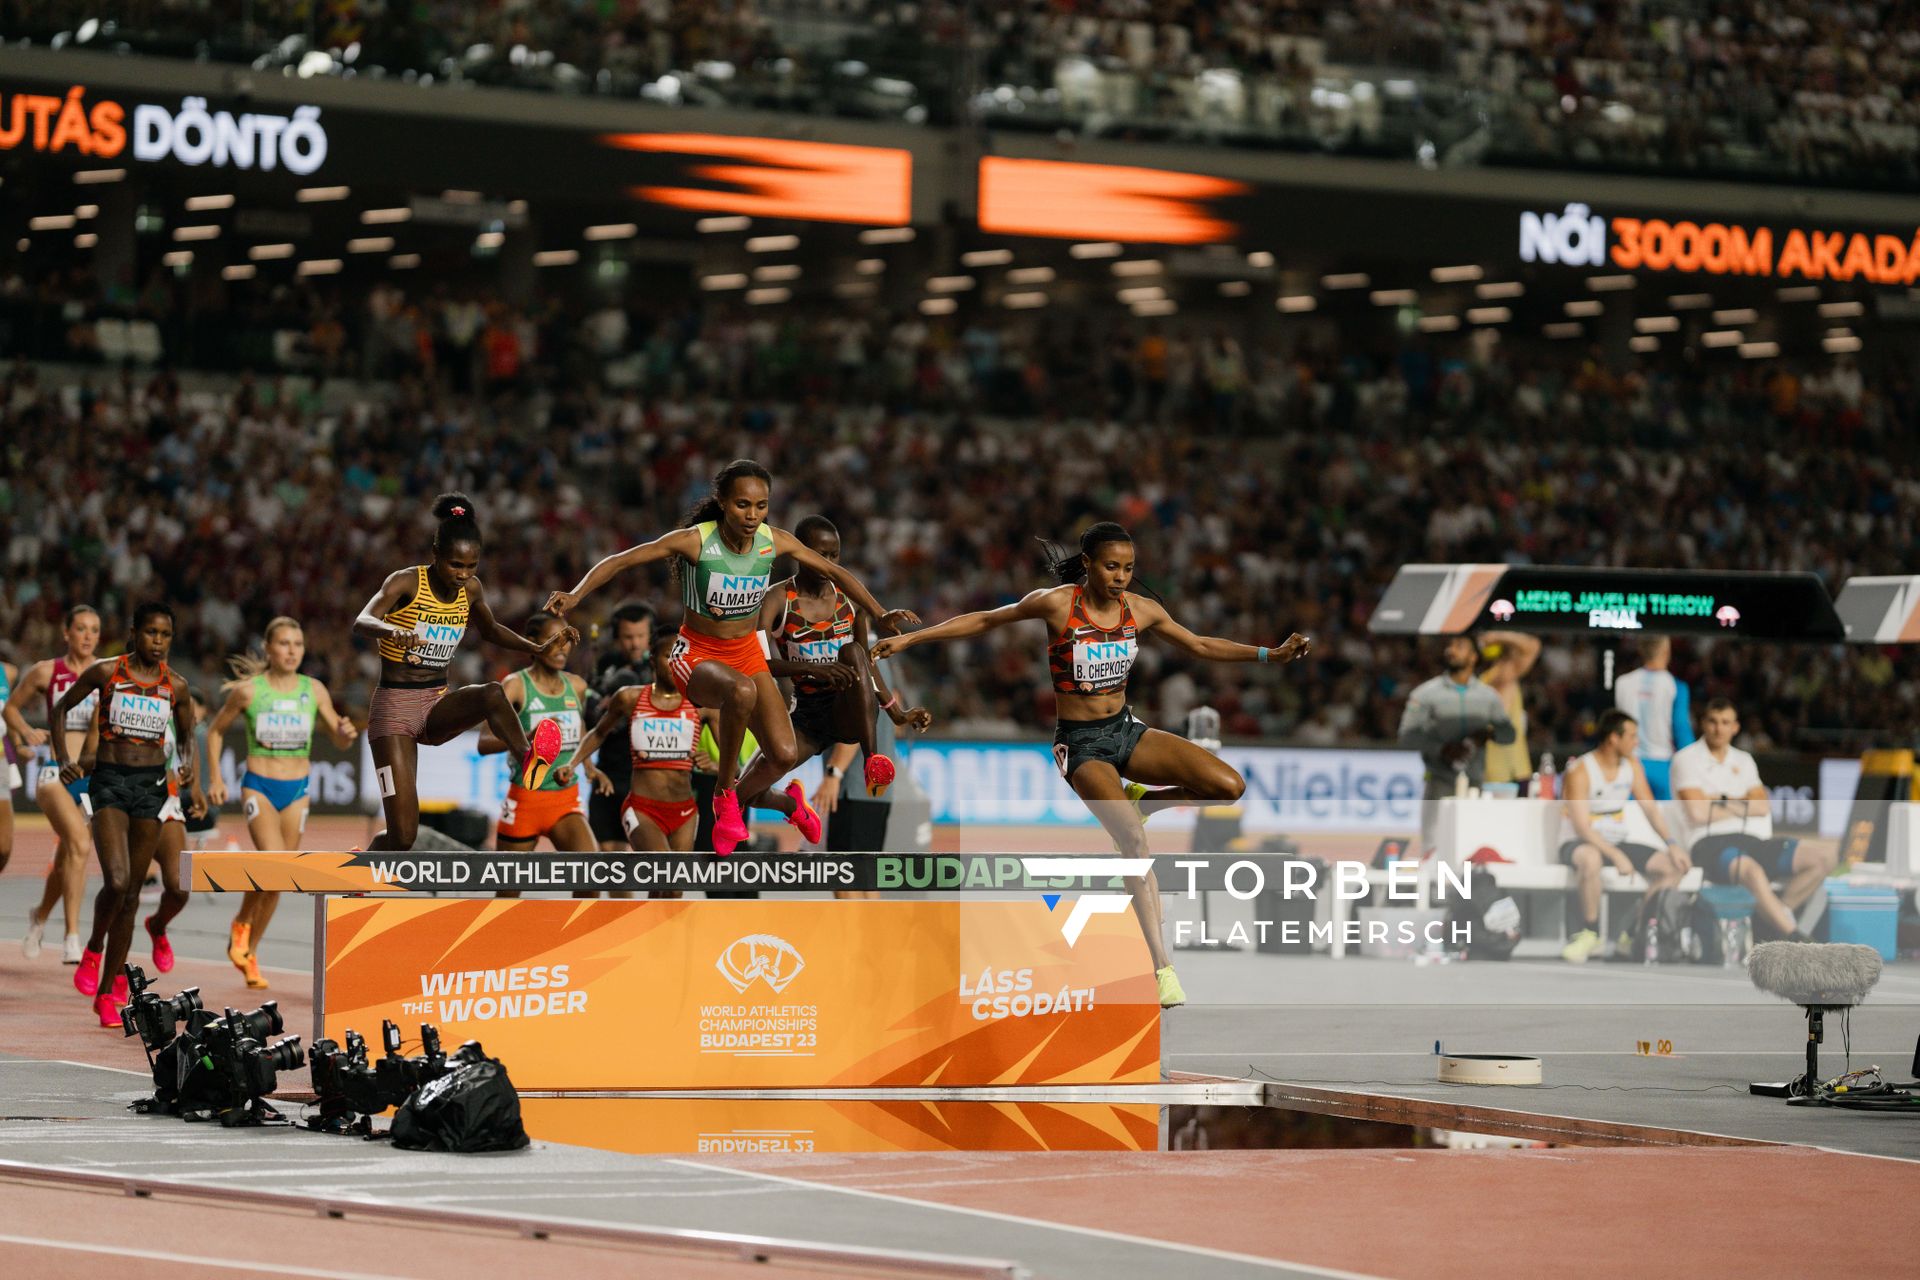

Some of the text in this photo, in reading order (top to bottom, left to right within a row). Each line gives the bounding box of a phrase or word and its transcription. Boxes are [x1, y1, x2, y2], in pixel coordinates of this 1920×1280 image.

[1611, 217, 1773, 277] 3000M
[723, 576, 767, 591] NTN
[1574, 591, 1647, 614] JAVELIN
[1649, 593, 1715, 617] THROW
[417, 612, 465, 625] UGANDA
[1588, 609, 1642, 629] FINAL
[425, 625, 462, 641] NTN
[799, 639, 842, 656] NTN
[1087, 642, 1129, 661] NTN
[1076, 664, 1087, 680] B.
[121, 695, 161, 713] NTN
[119, 710, 166, 730] CHEPKOECH
[267, 714, 302, 726] NTN
[643, 719, 683, 734] NTN
[646, 735, 679, 749] YAVI
[369, 861, 471, 884] WORLD
[480, 861, 626, 884] ATHLETICS
[633, 861, 855, 884] CHAMPIONSHIPS
[420, 964, 570, 997] WITNESS
[959, 966, 1033, 997] LÁSS
[401, 990, 588, 1023] THE WONDER
[700, 1005, 817, 1017] WORLD ATHLETICS
[971, 985, 1095, 1021] CSODÁT!
[699, 1018, 817, 1031] CHAMPIONSHIPS
[700, 1033, 817, 1047] BUDAPEST 23
